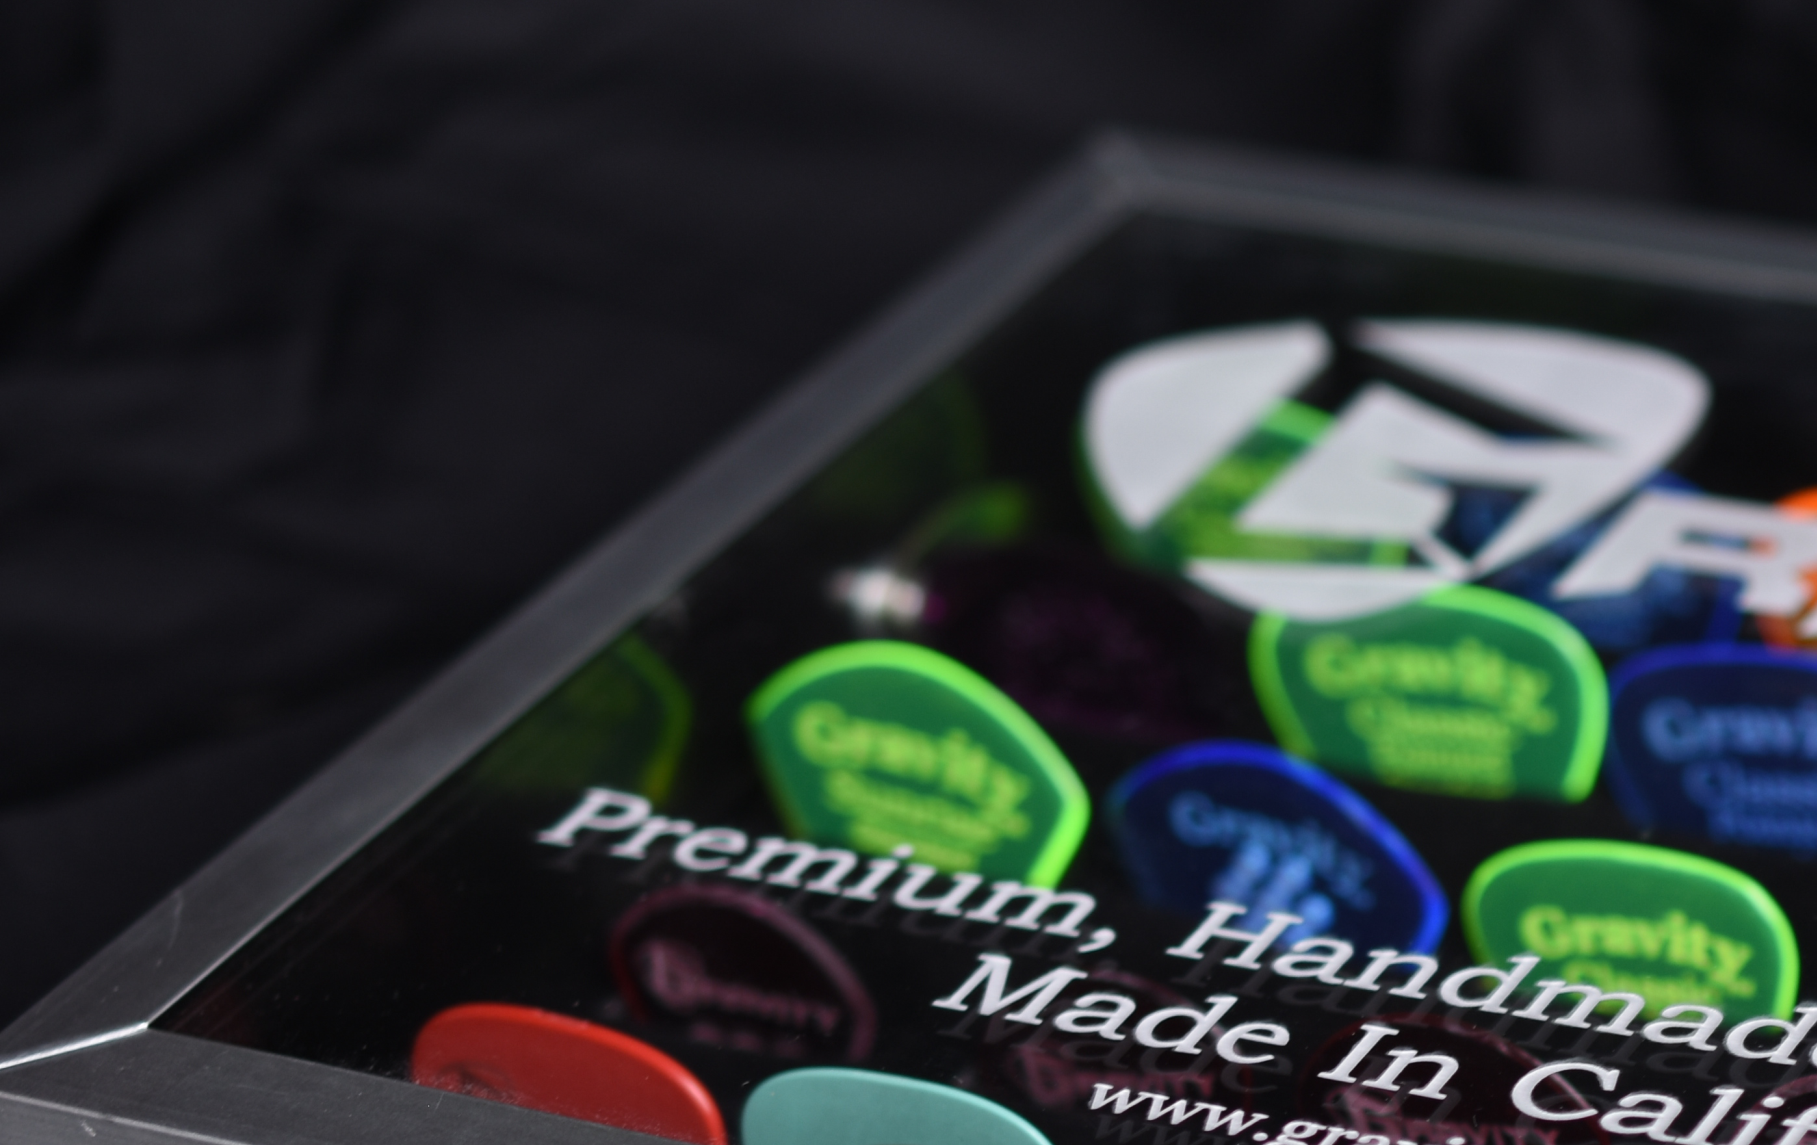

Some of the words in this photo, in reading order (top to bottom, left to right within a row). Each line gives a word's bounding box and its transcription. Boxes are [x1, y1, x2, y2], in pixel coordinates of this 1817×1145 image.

[538, 788, 1116, 953] Premium,
[932, 952, 1292, 1064] Made
[1316, 1020, 1462, 1102] In
